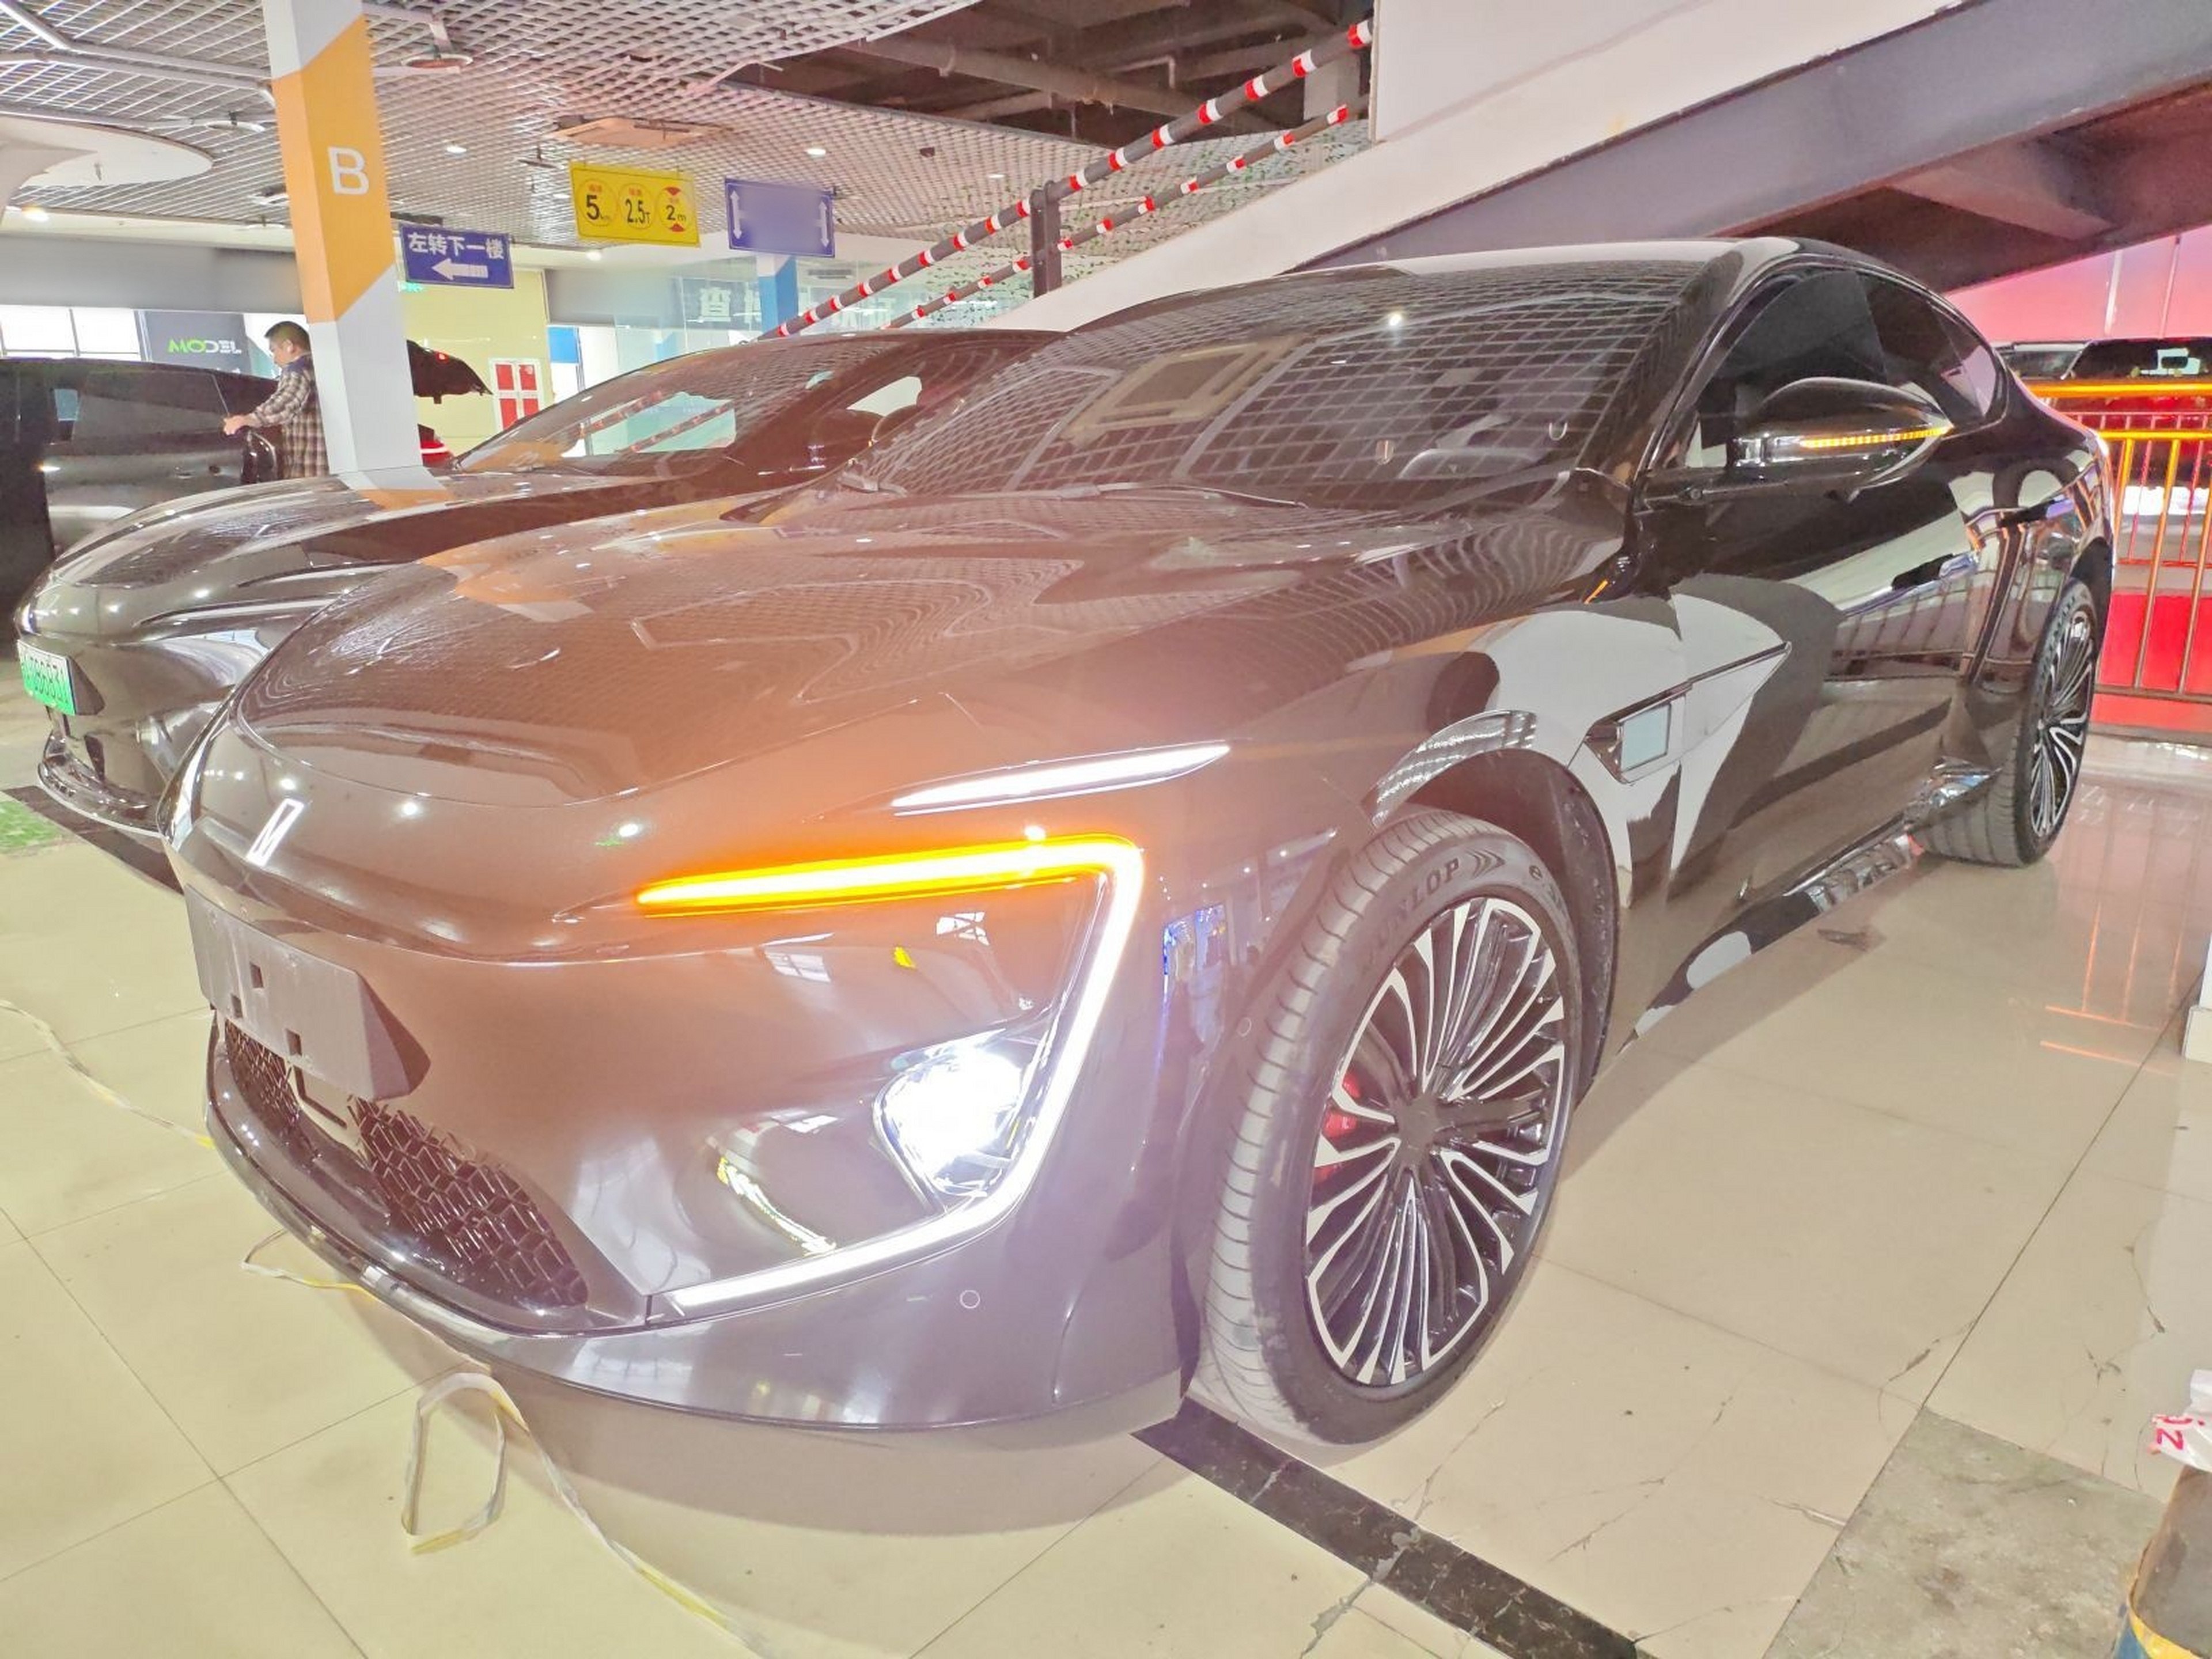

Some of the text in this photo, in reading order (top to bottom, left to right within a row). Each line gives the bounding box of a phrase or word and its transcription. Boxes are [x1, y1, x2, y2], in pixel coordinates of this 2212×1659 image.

[327, 146, 370, 195] B
[407, 232, 505, 260] 左转下一楼
[168, 338, 242, 354] MODEL
